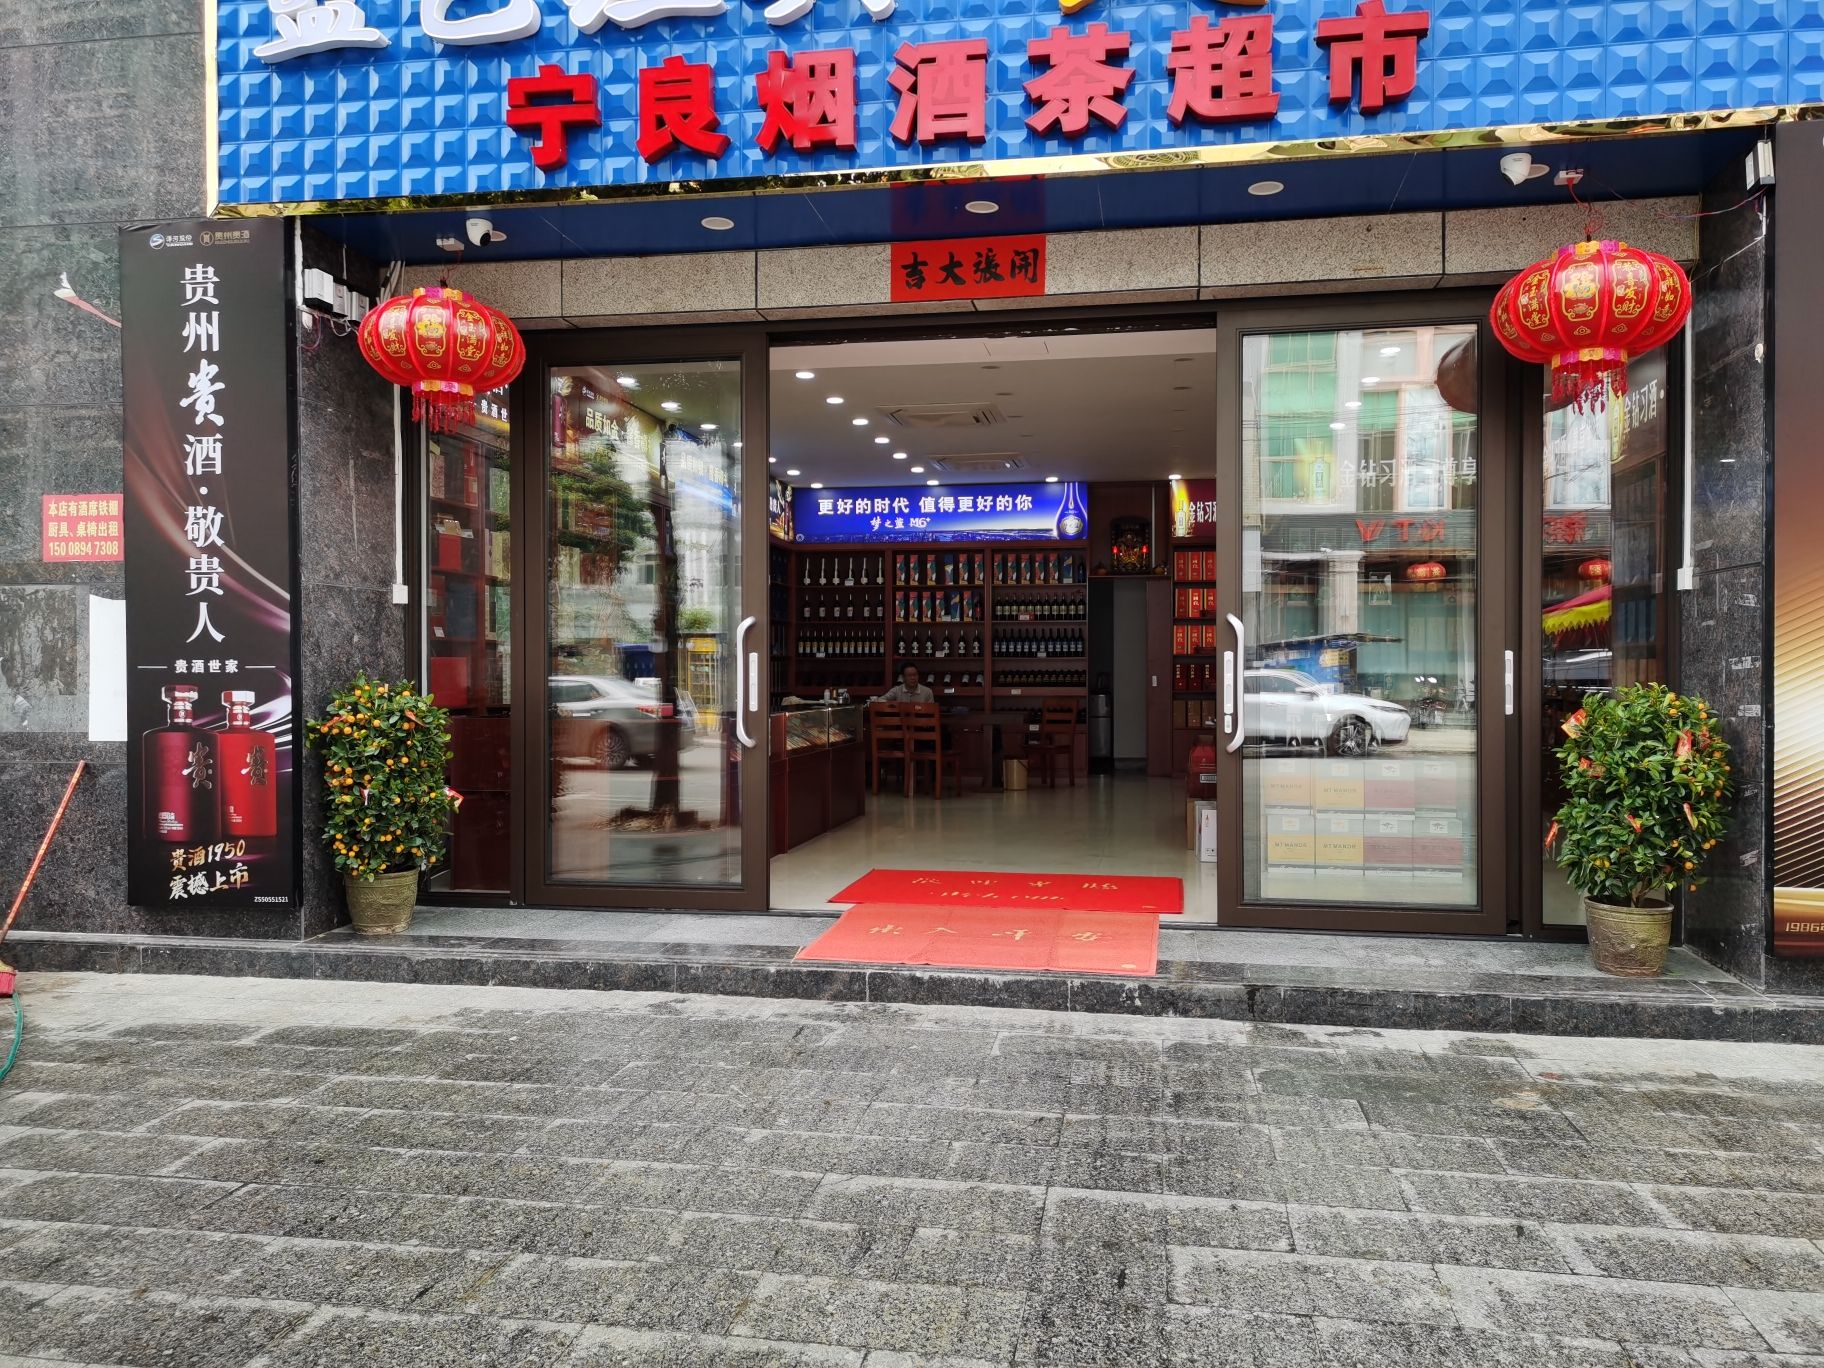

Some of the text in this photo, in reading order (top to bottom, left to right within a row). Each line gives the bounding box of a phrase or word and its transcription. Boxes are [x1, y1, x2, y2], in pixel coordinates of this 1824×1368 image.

[506, 0, 1429, 173] 宁良烟酒茶超市
[48, 499, 119, 517] 本店有酒席铁棚
[817, 494, 1034, 516] 更好的时代 值得更好的你
[48, 521, 119, 537] 厨具、桌椅出租
[49, 541, 119, 555] 150 0894 7308
[174, 659, 239, 674] 贵酒世家
[169, 862, 249, 900] 震撼上市
